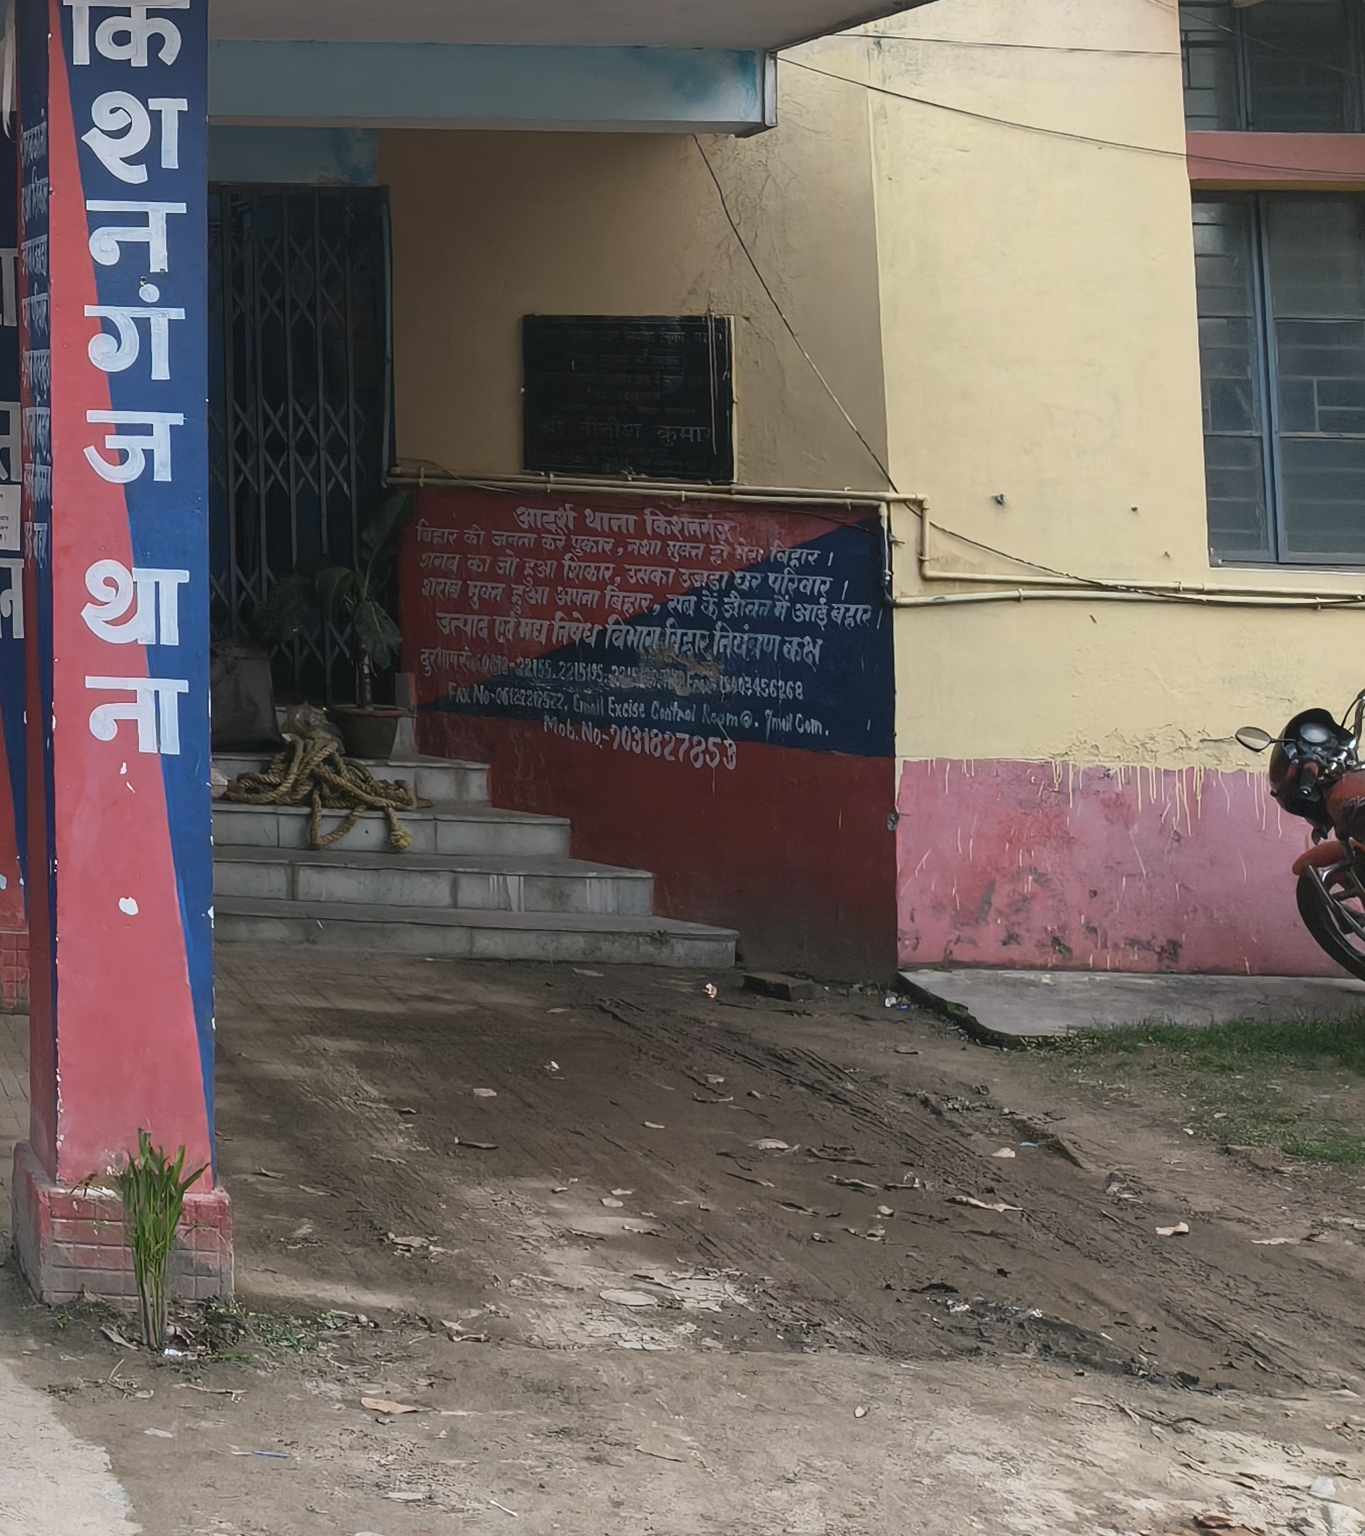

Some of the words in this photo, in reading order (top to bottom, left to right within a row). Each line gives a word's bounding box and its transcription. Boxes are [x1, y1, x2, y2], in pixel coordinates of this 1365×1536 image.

[515, 503, 578, 533] आदर्श
[584, 508, 638, 536] थाना
[415, 519, 459, 545] बिहार
[464, 523, 486, 545] की
[491, 531, 537, 548] जनता
[626, 538, 661, 556] नशा
[769, 541, 821, 569] बिहार
[466, 554, 492, 573] का
[496, 549, 519, 577] जो
[767, 567, 834, 597] परिवार
[555, 586, 601, 609] अपना
[608, 697, 645, 718] Excise
